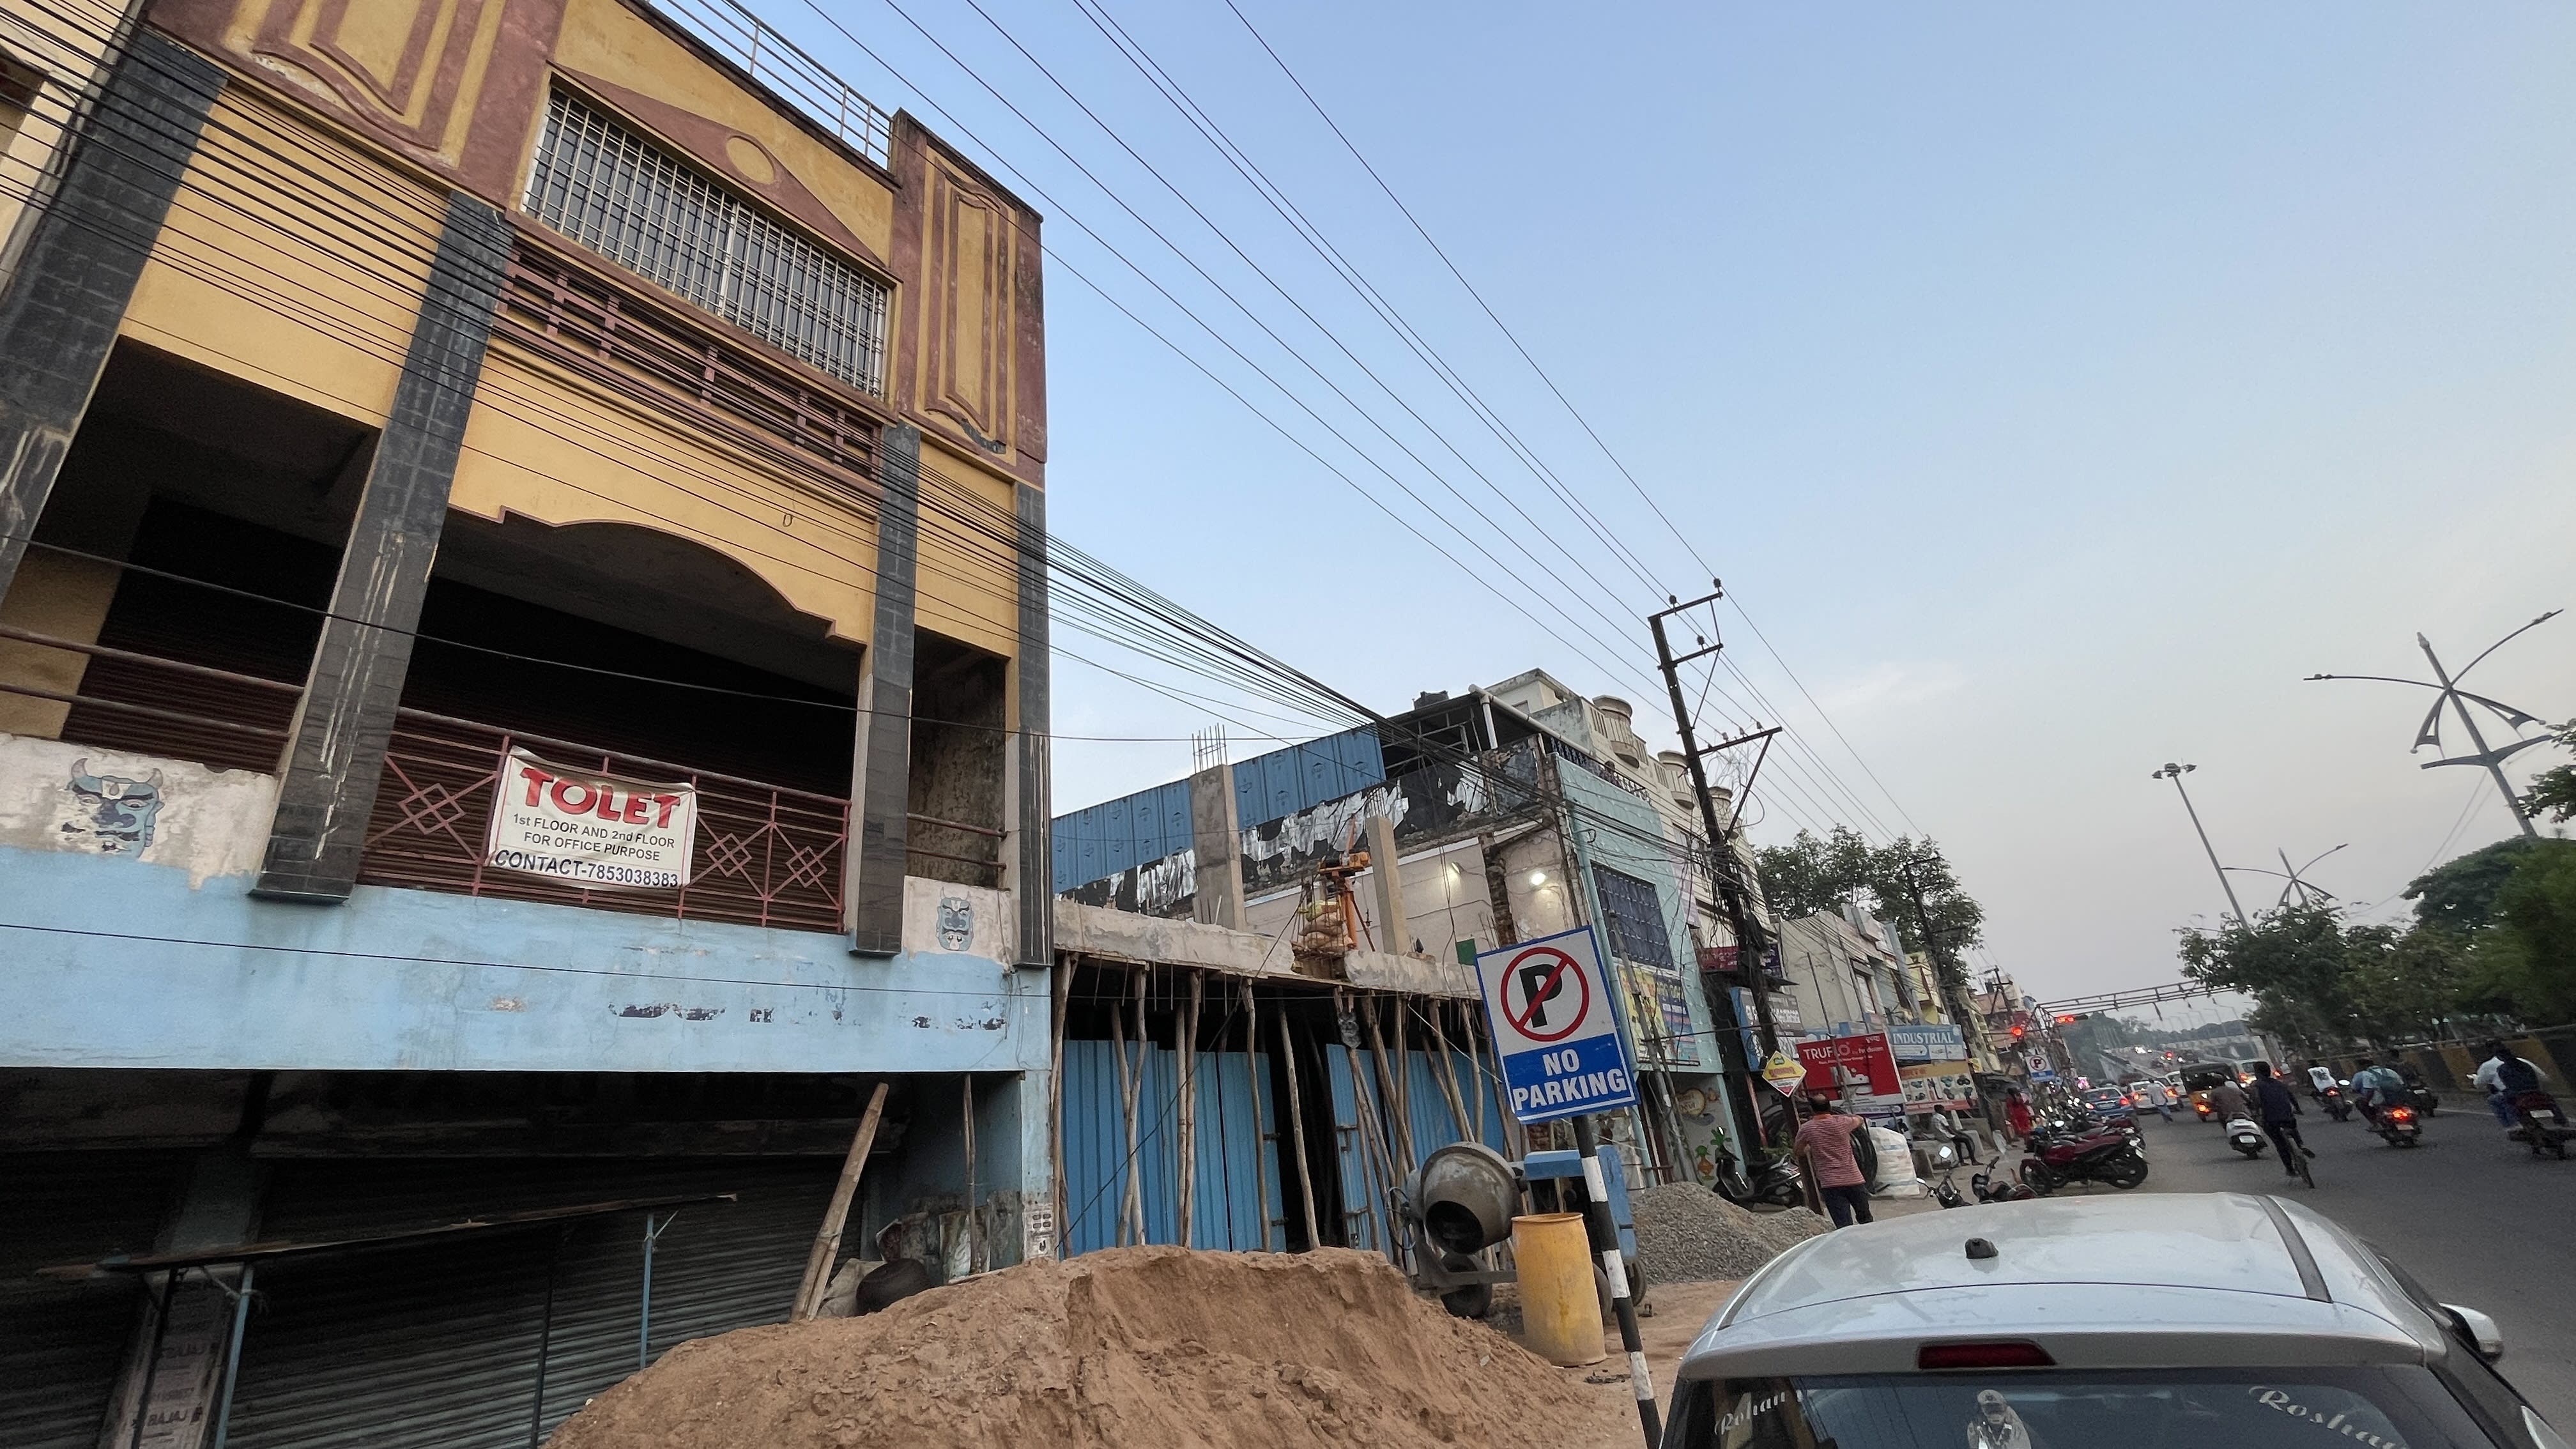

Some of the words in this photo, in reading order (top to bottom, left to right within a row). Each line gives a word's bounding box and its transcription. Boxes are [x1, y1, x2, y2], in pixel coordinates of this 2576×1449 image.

[513, 813, 530, 827] 1st
[534, 818, 579, 835] FLOOR
[581, 825, 608, 839] AND
[612, 831, 632, 841] 2nd
[635, 833, 675, 848] FLOOR
[524, 832, 550, 846] FOR
[555, 838, 601, 852] OFFICE
[604, 843, 660, 861] PURPOSE
[1892, 1031, 1954, 1045] INDUSTRIAL
[1542, 1048, 1580, 1077] NO
[1512, 1068, 1627, 1111] PARKING
